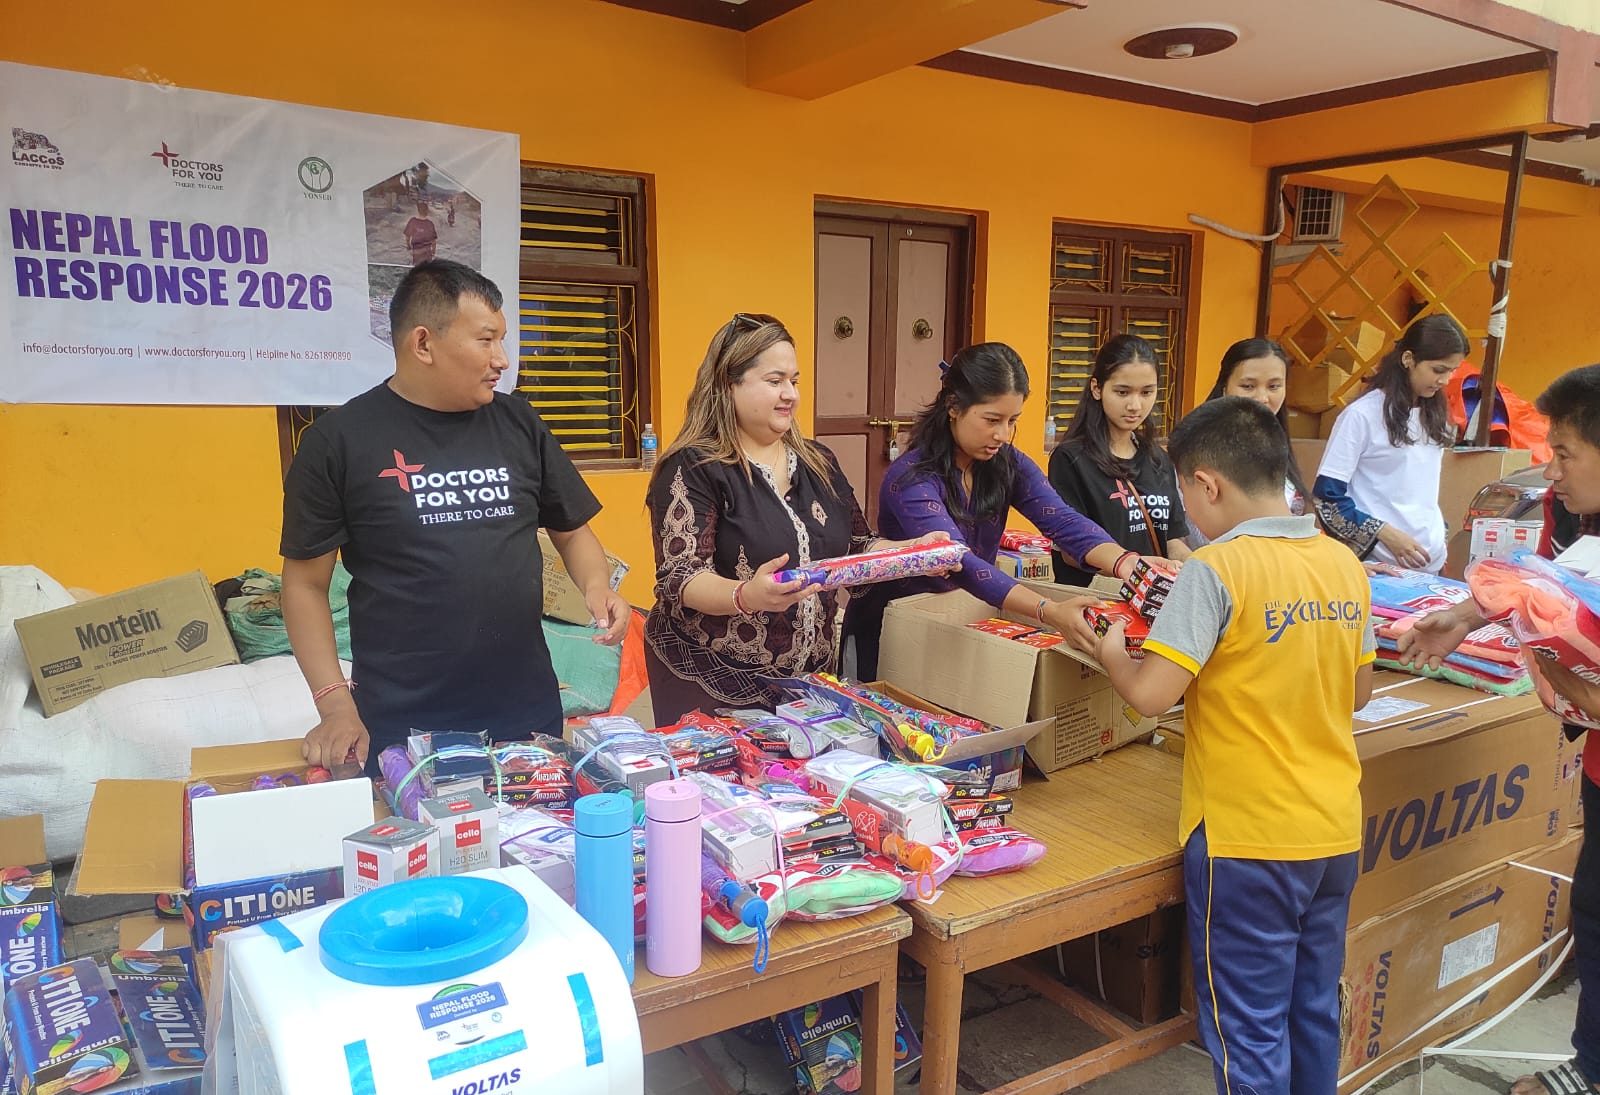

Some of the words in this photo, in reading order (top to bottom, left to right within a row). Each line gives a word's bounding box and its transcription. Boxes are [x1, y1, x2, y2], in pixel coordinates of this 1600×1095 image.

[172, 159, 224, 172] DOCTORS
[172, 169, 195, 179] FOR
[199, 172, 222, 181] YOU
[10, 208, 141, 257] NEPAL
[149, 219, 268, 265] FLOOD
[14, 256, 229, 306] RESPONSE
[237, 269, 332, 311] 2026
[23, 343, 133, 357] info@doctorsforyou.org
[145, 346, 246, 360] www.doctorsforyou.org
[256, 349, 289, 360] Helpline
[290, 349, 303, 360] No.
[411, 467, 510, 490] DOCTORS
[414, 491, 462, 509] FOR
[463, 485, 510, 504] YOU
[419, 511, 464, 525] THERE
[467, 509, 483, 521] TO
[485, 505, 515, 519] CARE
[1148, 508, 1170, 520] OU
[75, 608, 161, 651] Mortein
[109, 639, 145, 656] POWER
[1361, 764, 1529, 874] VOLTAS
[456, 829, 480, 840] cello
[358, 860, 378, 872] cello
[409, 853, 427, 868] cello
[468, 851, 488, 862] SLIM
[0, 905, 49, 915] mbrella
[430, 1001, 475, 1020] RESPONSE
[476, 995, 496, 1006] 2026
[432, 1000, 461, 1013] NEPAL
[461, 990, 490, 1002] FLOOD
[1366, 950, 1392, 1058] VOLTAS
[801, 1014, 852, 1040] Umbrella
[38, 1035, 121, 1068] Umbrella
